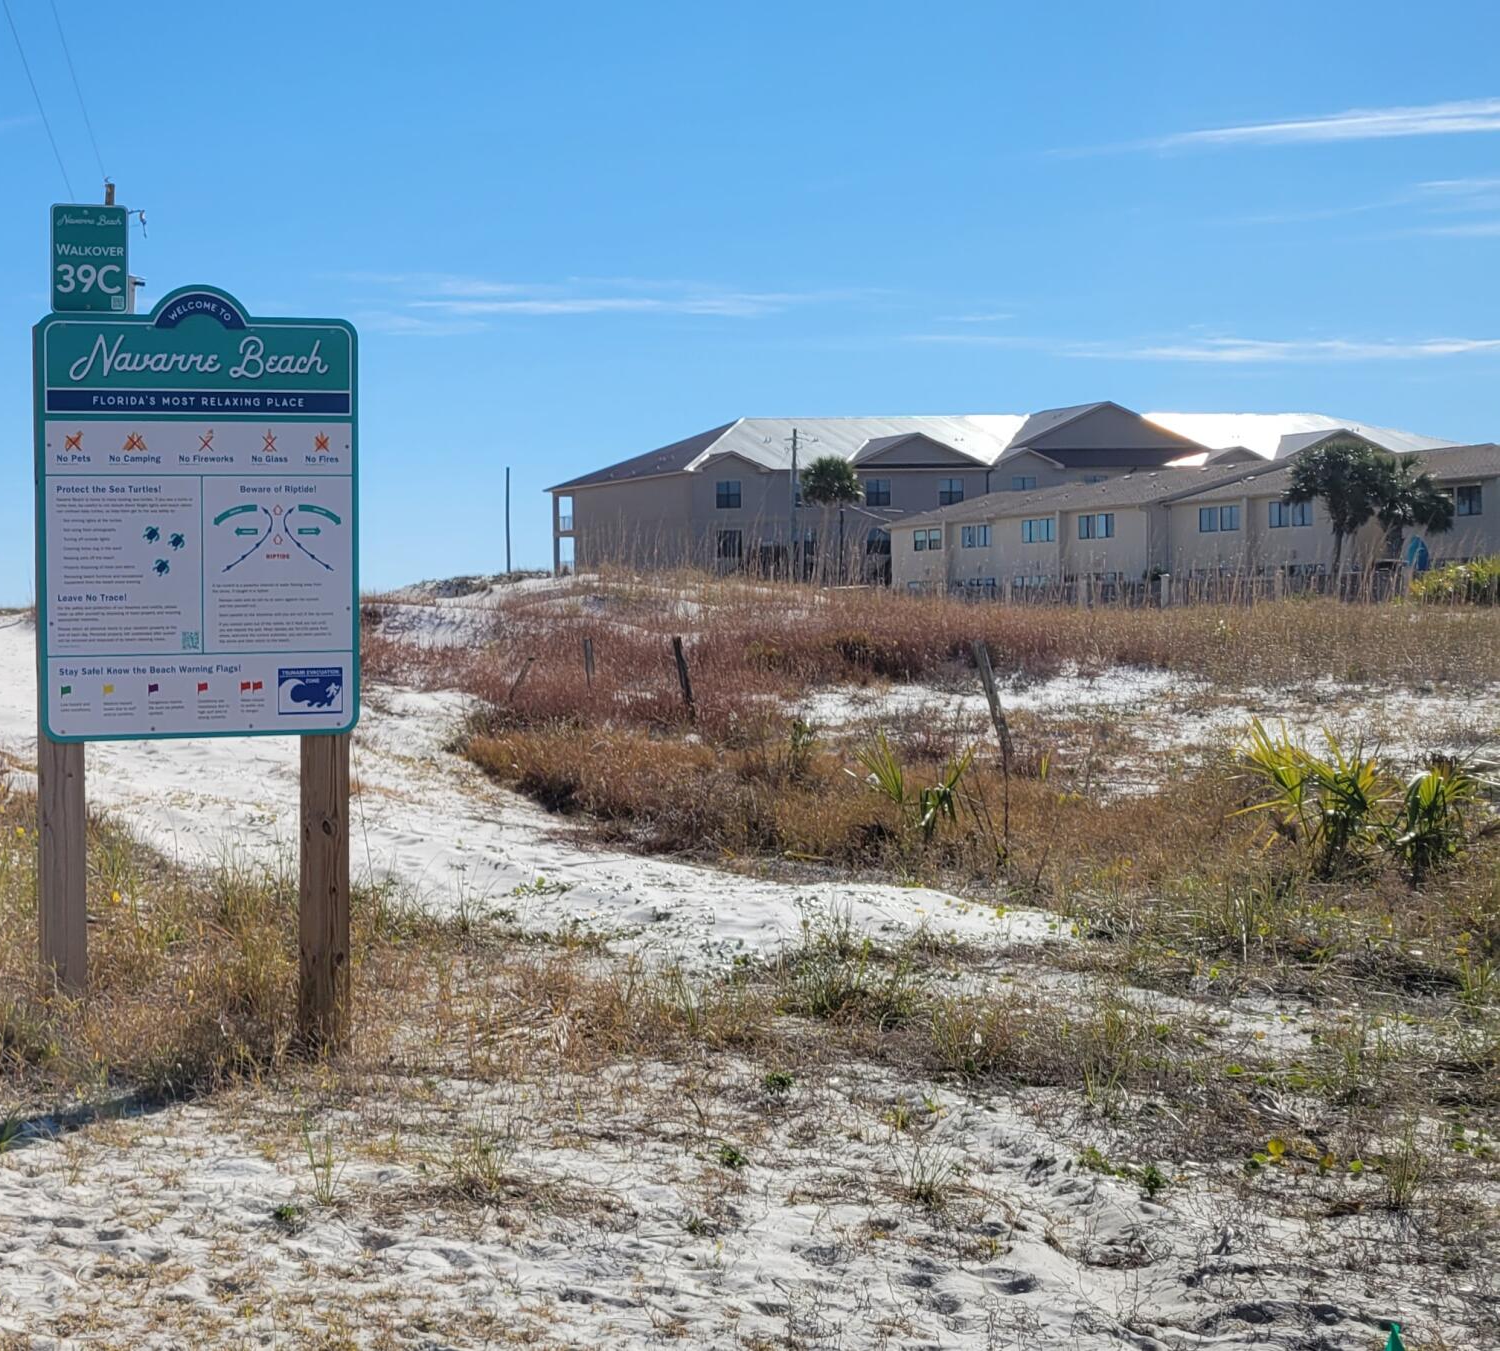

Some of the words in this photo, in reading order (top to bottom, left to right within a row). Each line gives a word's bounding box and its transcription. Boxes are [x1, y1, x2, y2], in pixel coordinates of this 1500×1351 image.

[57, 214, 94, 226] Navarre
[96, 215, 122, 226] Beach
[56, 243, 124, 256] WALKOVER
[56, 264, 122, 294] 39C
[168, 301, 217, 320] WELCOME
[219, 308, 232, 321] TO
[69, 334, 221, 381] Navarre
[228, 336, 329, 379] Beach
[92, 395, 157, 406] FLORIDA'S
[162, 396, 196, 407] MOST
[201, 397, 261, 407] RELAXING
[266, 397, 305, 408] PLACE
[56, 454, 70, 463] No
[71, 454, 91, 464] Pets
[108, 454, 121, 463] No
[122, 454, 161, 465] Camping
[179, 454, 191, 463] No
[192, 454, 234, 464] Fireworks
[251, 454, 264, 463] No
[264, 454, 288, 464] Glass
[304, 454, 317, 463] No
[318, 454, 339, 464] Fires
[56, 485, 89, 494] Protect
[91, 485, 107, 494] the
[109, 485, 127, 494] Sea
[128, 485, 162, 494] Turtles!
[240, 485, 271, 494] Beware
[273, 485, 283, 494] of
[284, 485, 317, 495] Riptide!
[57, 594, 83, 603] Leave
[85, 593, 97, 602] No
[99, 592, 127, 602] Trace!
[59, 668, 78, 677] Stay
[81, 667, 103, 676] Safe!
[106, 667, 130, 675] Know
[132, 667, 147, 675] the
[149, 666, 176, 674] Beach
[179, 665, 214, 675] Warning
[215, 664, 242, 674] Flags!
